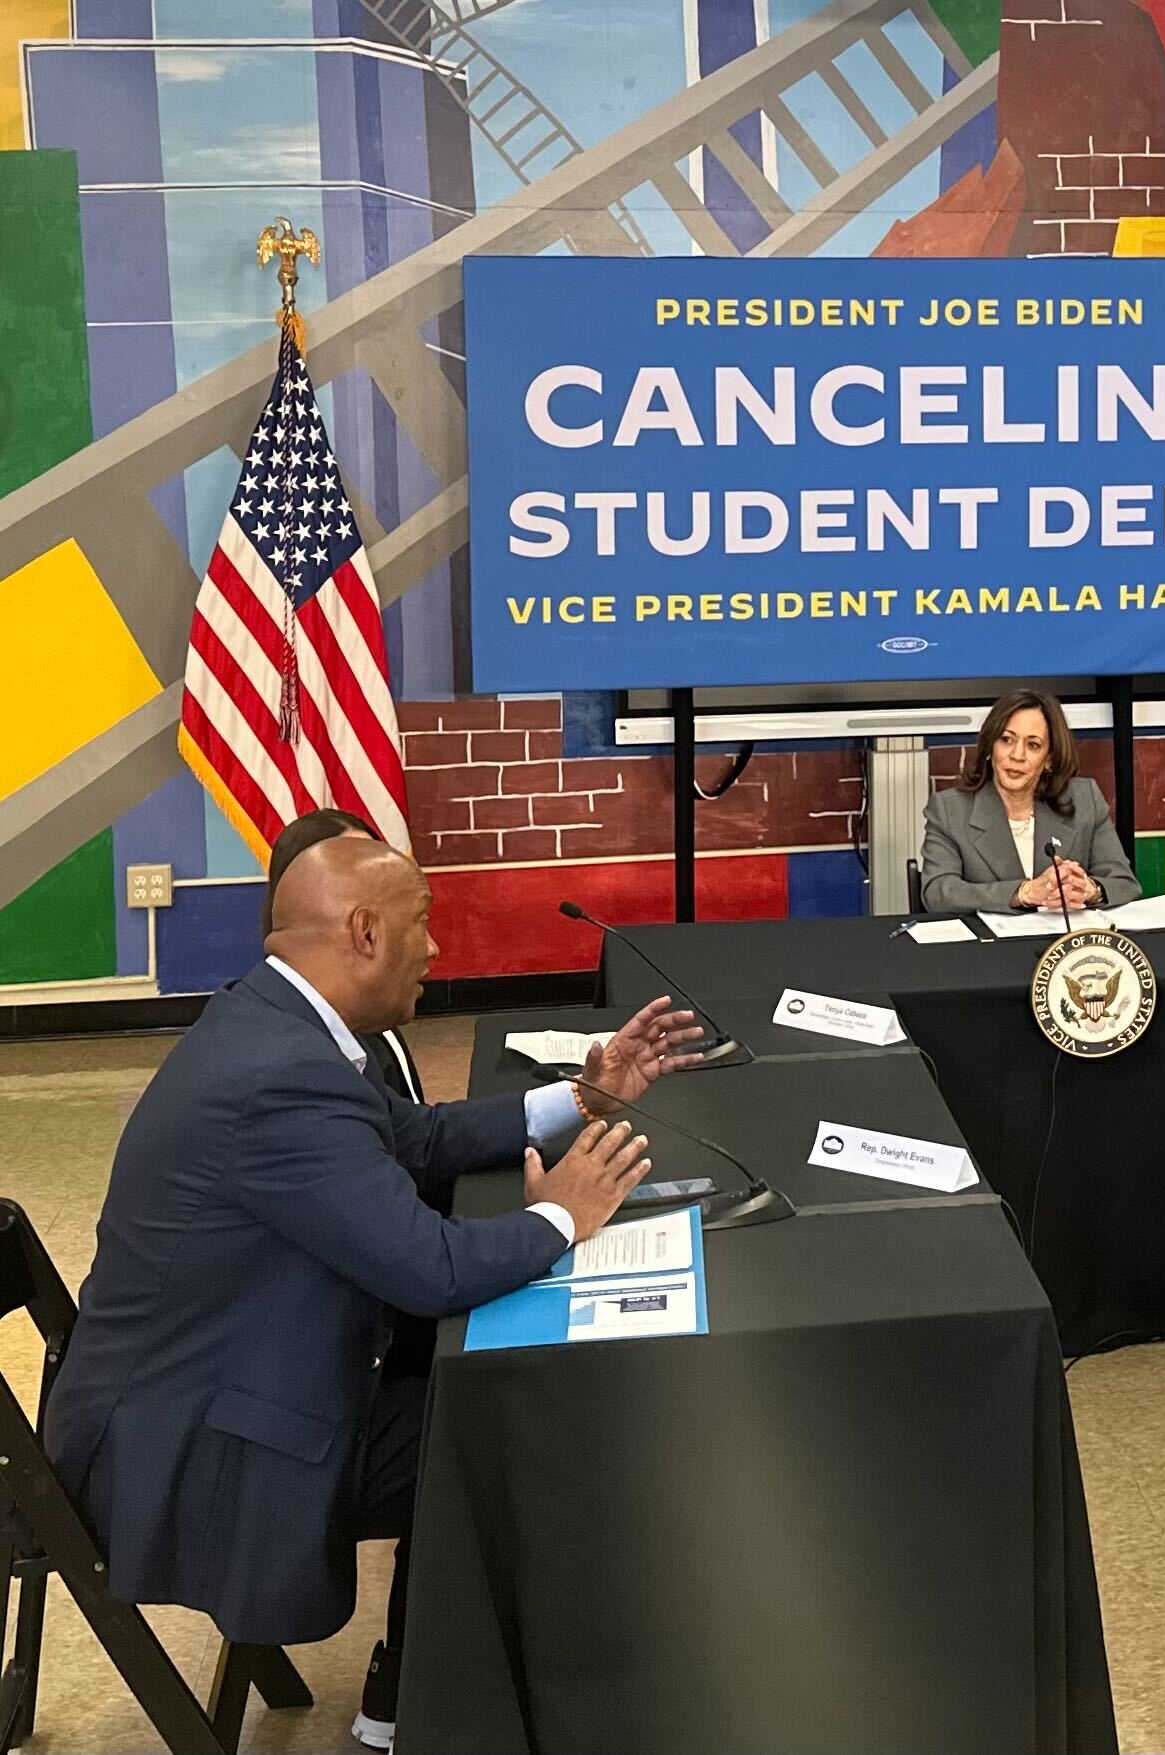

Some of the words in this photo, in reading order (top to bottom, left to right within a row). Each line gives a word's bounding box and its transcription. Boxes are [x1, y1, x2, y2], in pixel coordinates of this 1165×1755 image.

[657, 299, 904, 325] PRESIDENT
[920, 299, 999, 325] JOE
[1017, 299, 1142, 324] BIDEN
[510, 488, 998, 557] STUDENT
[507, 597, 616, 623] VICE
[636, 591, 897, 621] PRESIDENT
[916, 586, 1101, 614] KAMALA
[1072, 936, 1085, 947] OF
[1090, 935, 1112, 945] THE
[1117, 940, 1152, 989] UNITED
[1035, 944, 1065, 1020] PRESIDENT
[1047, 1024, 1076, 1051] VICE
[1116, 998, 1153, 1045] STATES
[861, 1142, 877, 1154] Rep.
[881, 1146, 908, 1159] Dwight
[910, 1152, 934, 1165] Evans
